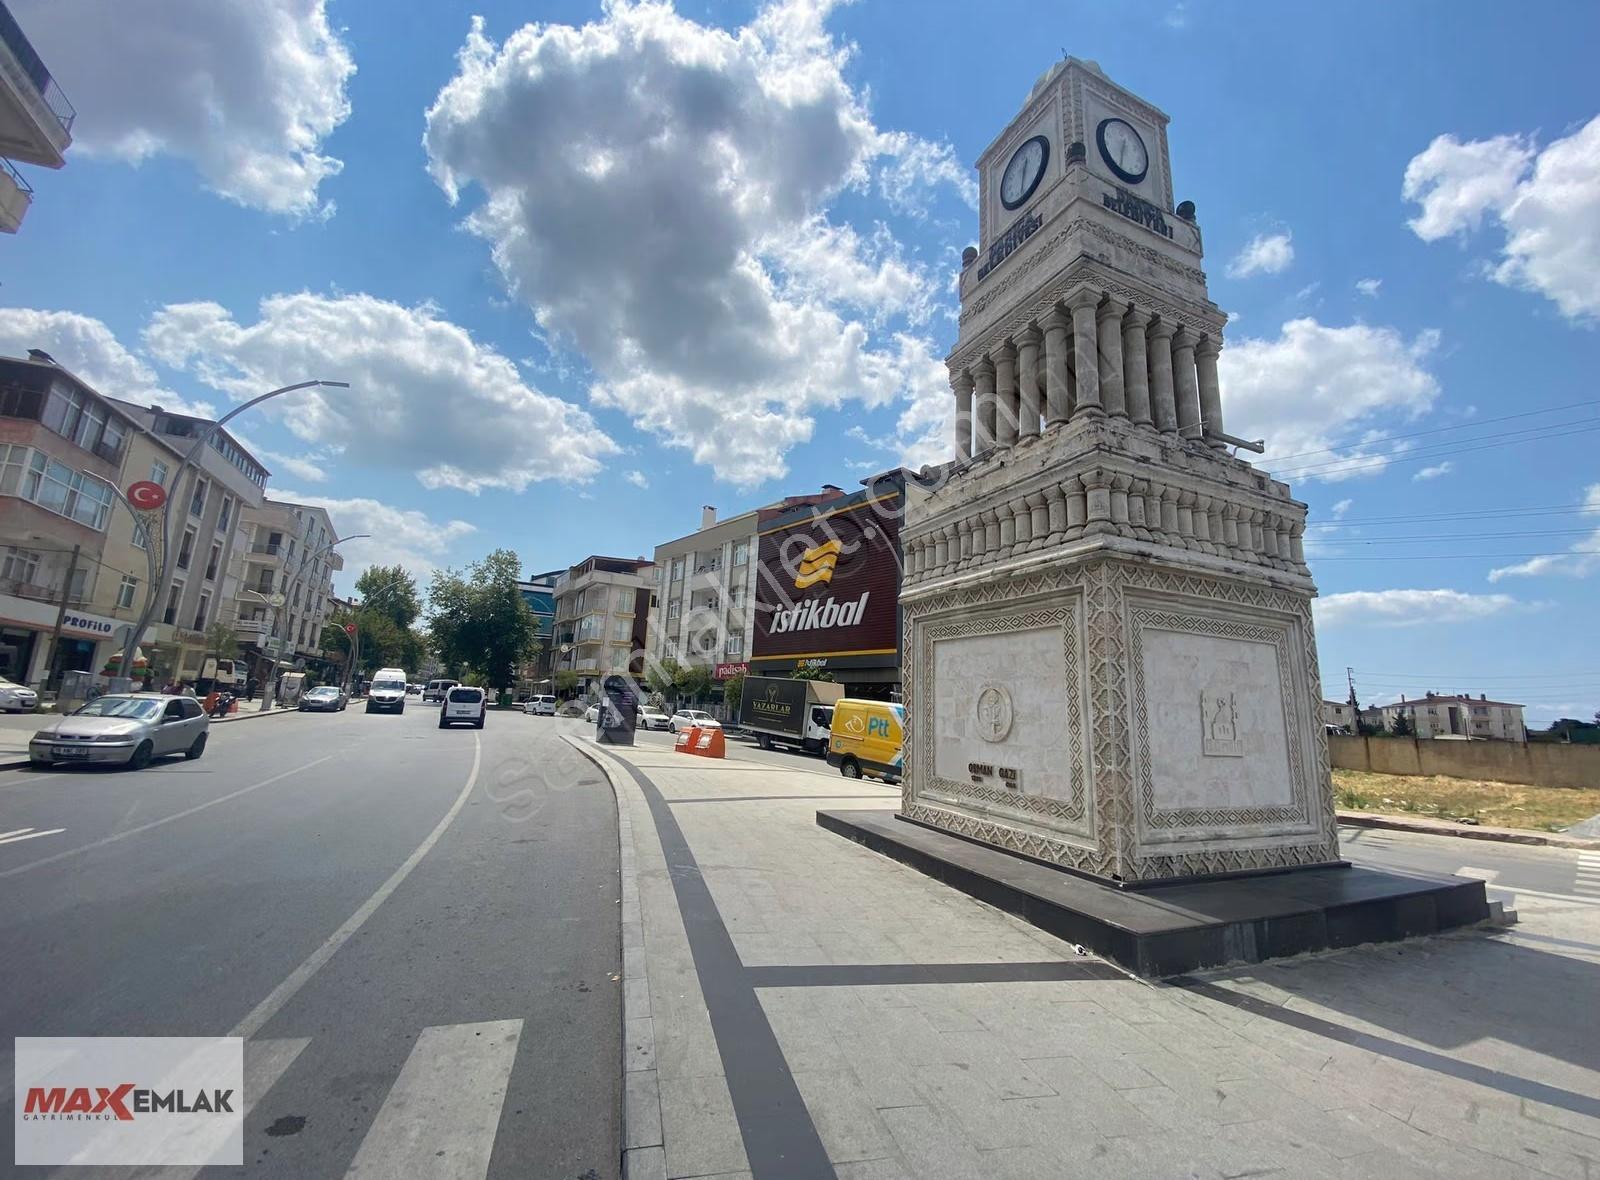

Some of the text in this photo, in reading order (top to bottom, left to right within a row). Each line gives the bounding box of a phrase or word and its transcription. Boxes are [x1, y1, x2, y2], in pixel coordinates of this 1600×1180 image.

[769, 591, 870, 634] istikbal
[868, 716, 890, 737] Ptt
[968, 763, 993, 776] OSMAN
